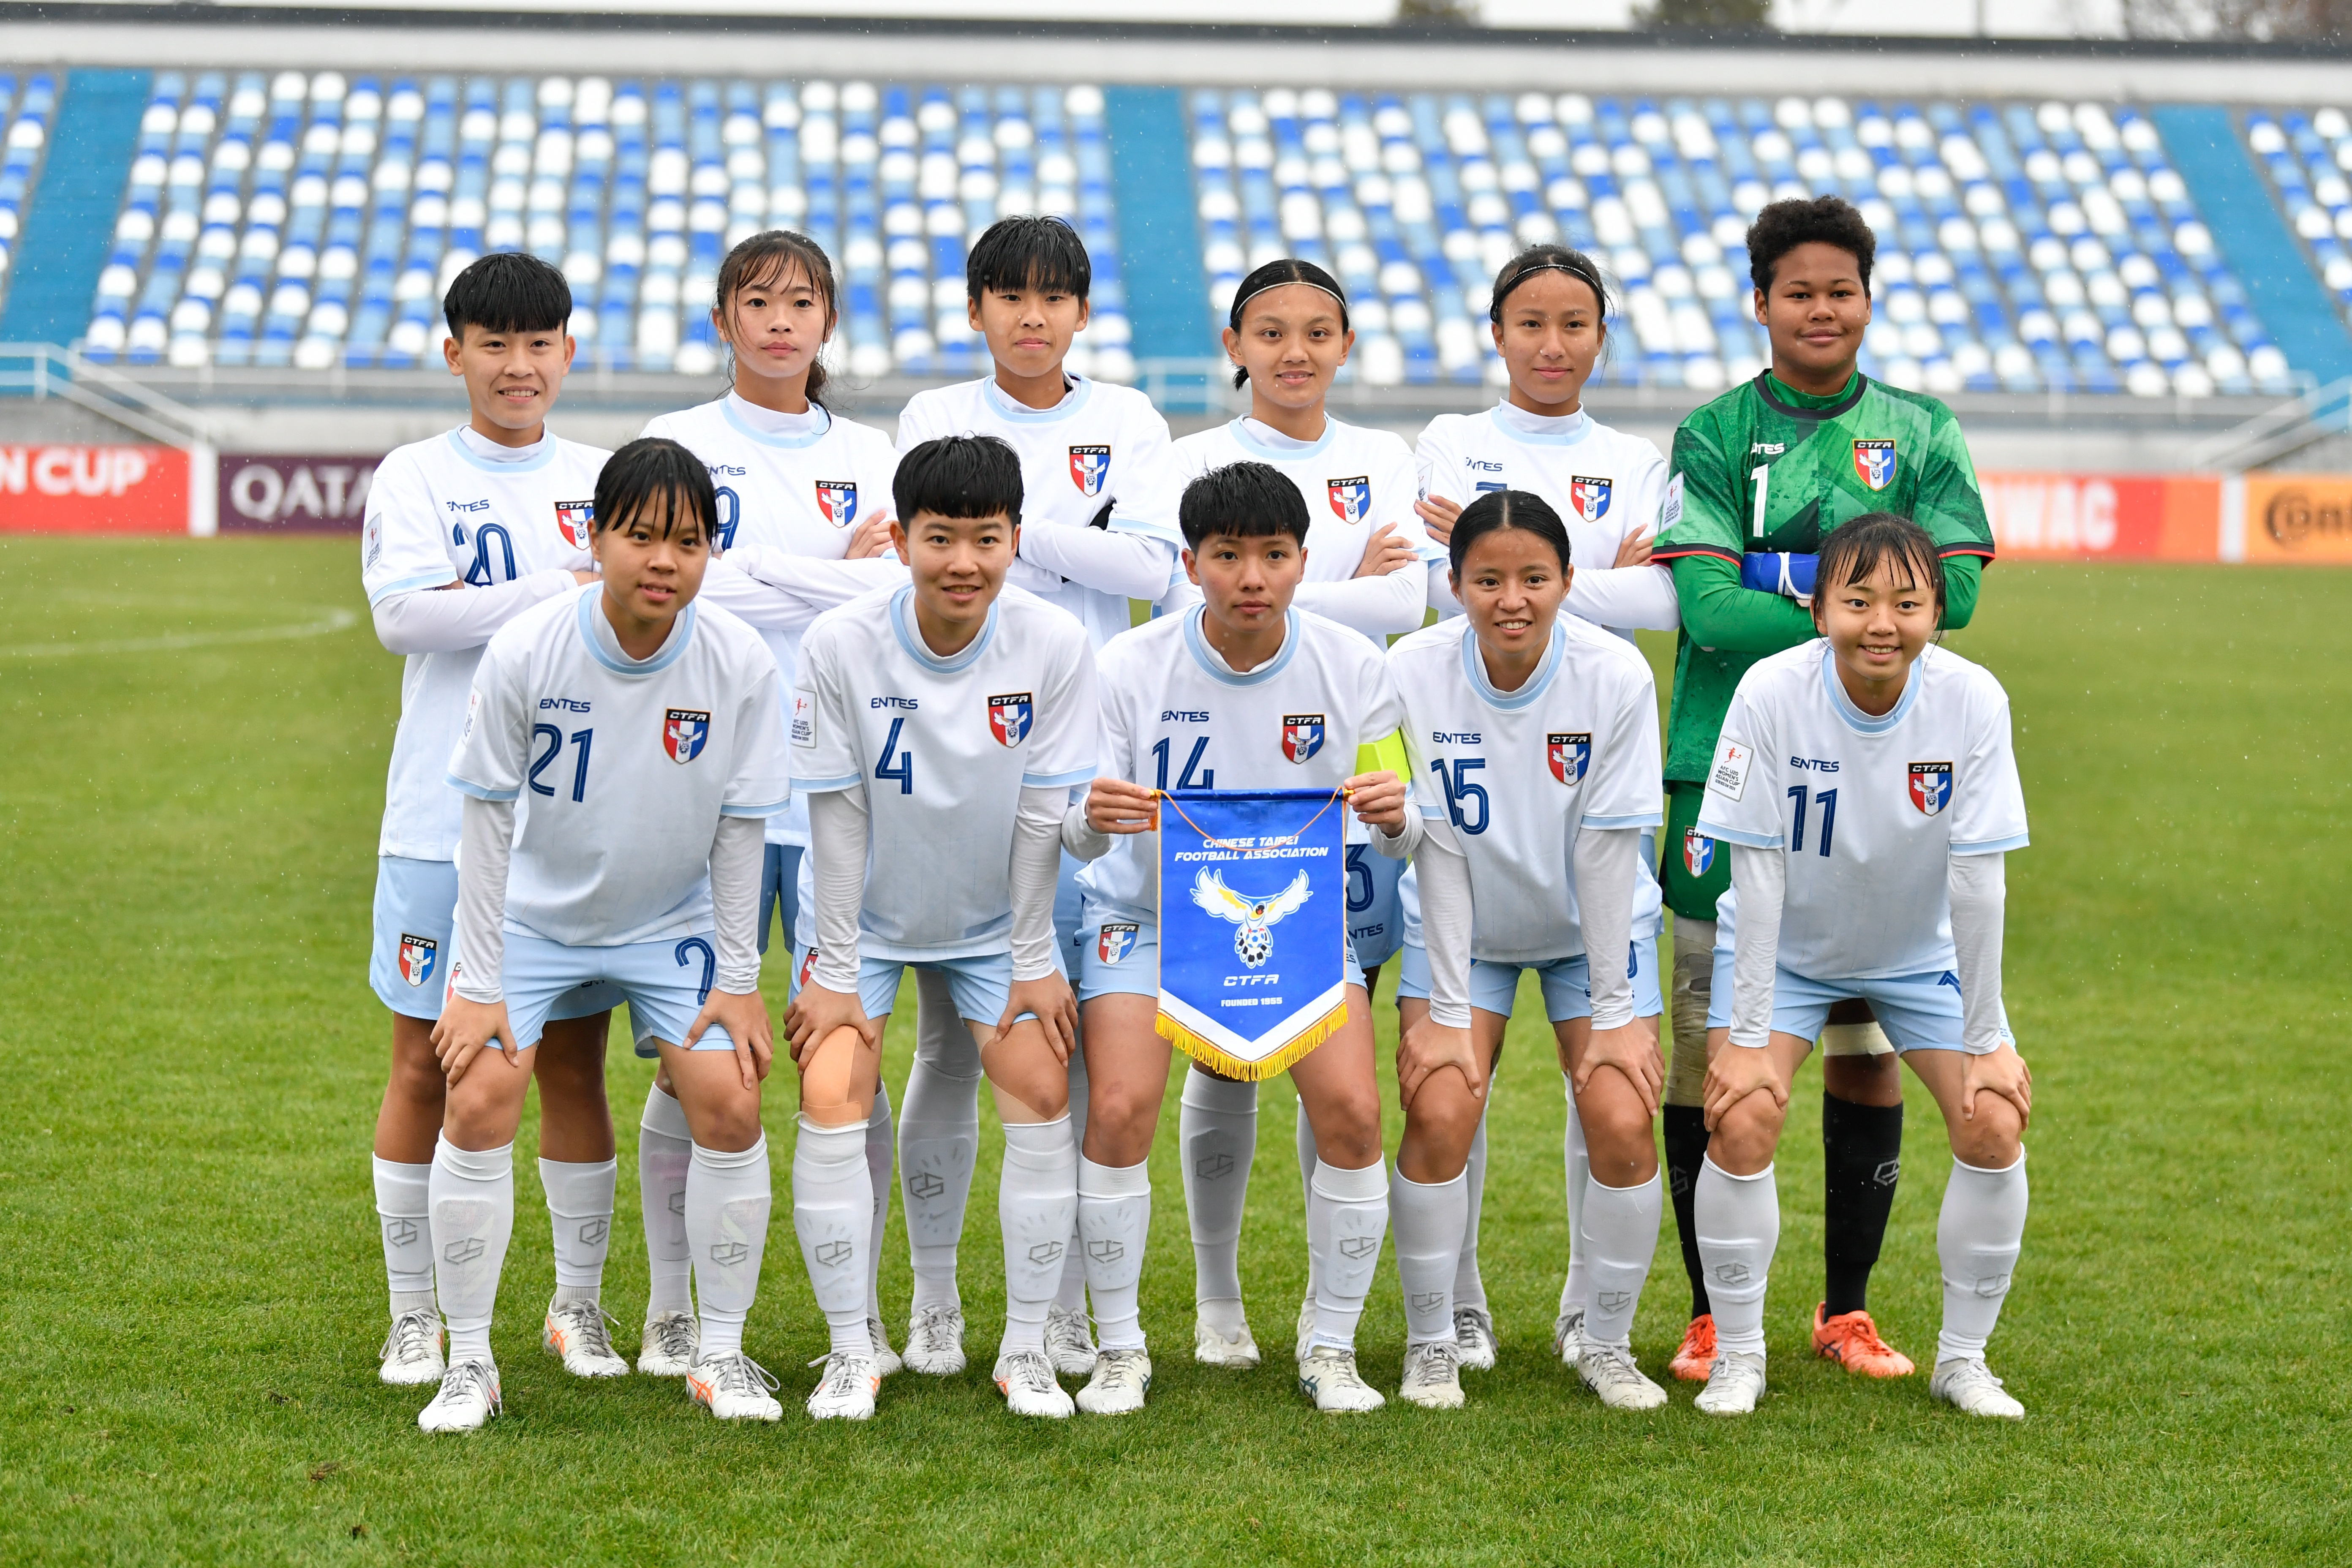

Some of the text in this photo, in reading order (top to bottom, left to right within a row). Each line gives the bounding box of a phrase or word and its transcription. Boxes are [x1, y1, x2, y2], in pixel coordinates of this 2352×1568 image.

[1073, 446, 1108, 455] CTFA
[33, 446, 148, 497] CUP
[706, 465, 746, 476] NTES
[1331, 478, 1366, 487] CTFA
[1575, 477, 1610, 486] CTFA
[230, 464, 374, 523] QATA
[1750, 463, 1768, 538] 1
[539, 698, 591, 712] ENTES
[871, 697, 918, 710] ENTES
[991, 695, 1029, 705] CTFA
[670, 711, 707, 721] CTFA
[1161, 710, 1209, 722] ENTES
[1433, 731, 1481, 744] ENTES
[875, 718, 912, 795] 4
[1152, 736, 1214, 789] 14
[529, 724, 593, 803] 21
[1790, 756, 1839, 772] ENTES
[1912, 764, 1949, 772] CTFA
[1715, 773, 1729, 782] ASIAN
[1718, 769, 1739, 781] WOMEN'S
[1431, 758, 1489, 835] 15
[1787, 785, 1838, 858] 11
[1203, 836, 1299, 849] CHINESE TAIPEI
[1175, 847, 1328, 862] FOOTBALL ASSOCIATION
[1348, 923, 1383, 940] NTES
[404, 936, 435, 948] CTFA
[1223, 974, 1279, 986] CTFA
[1221, 997, 1282, 1007] FOUNDED 1955
